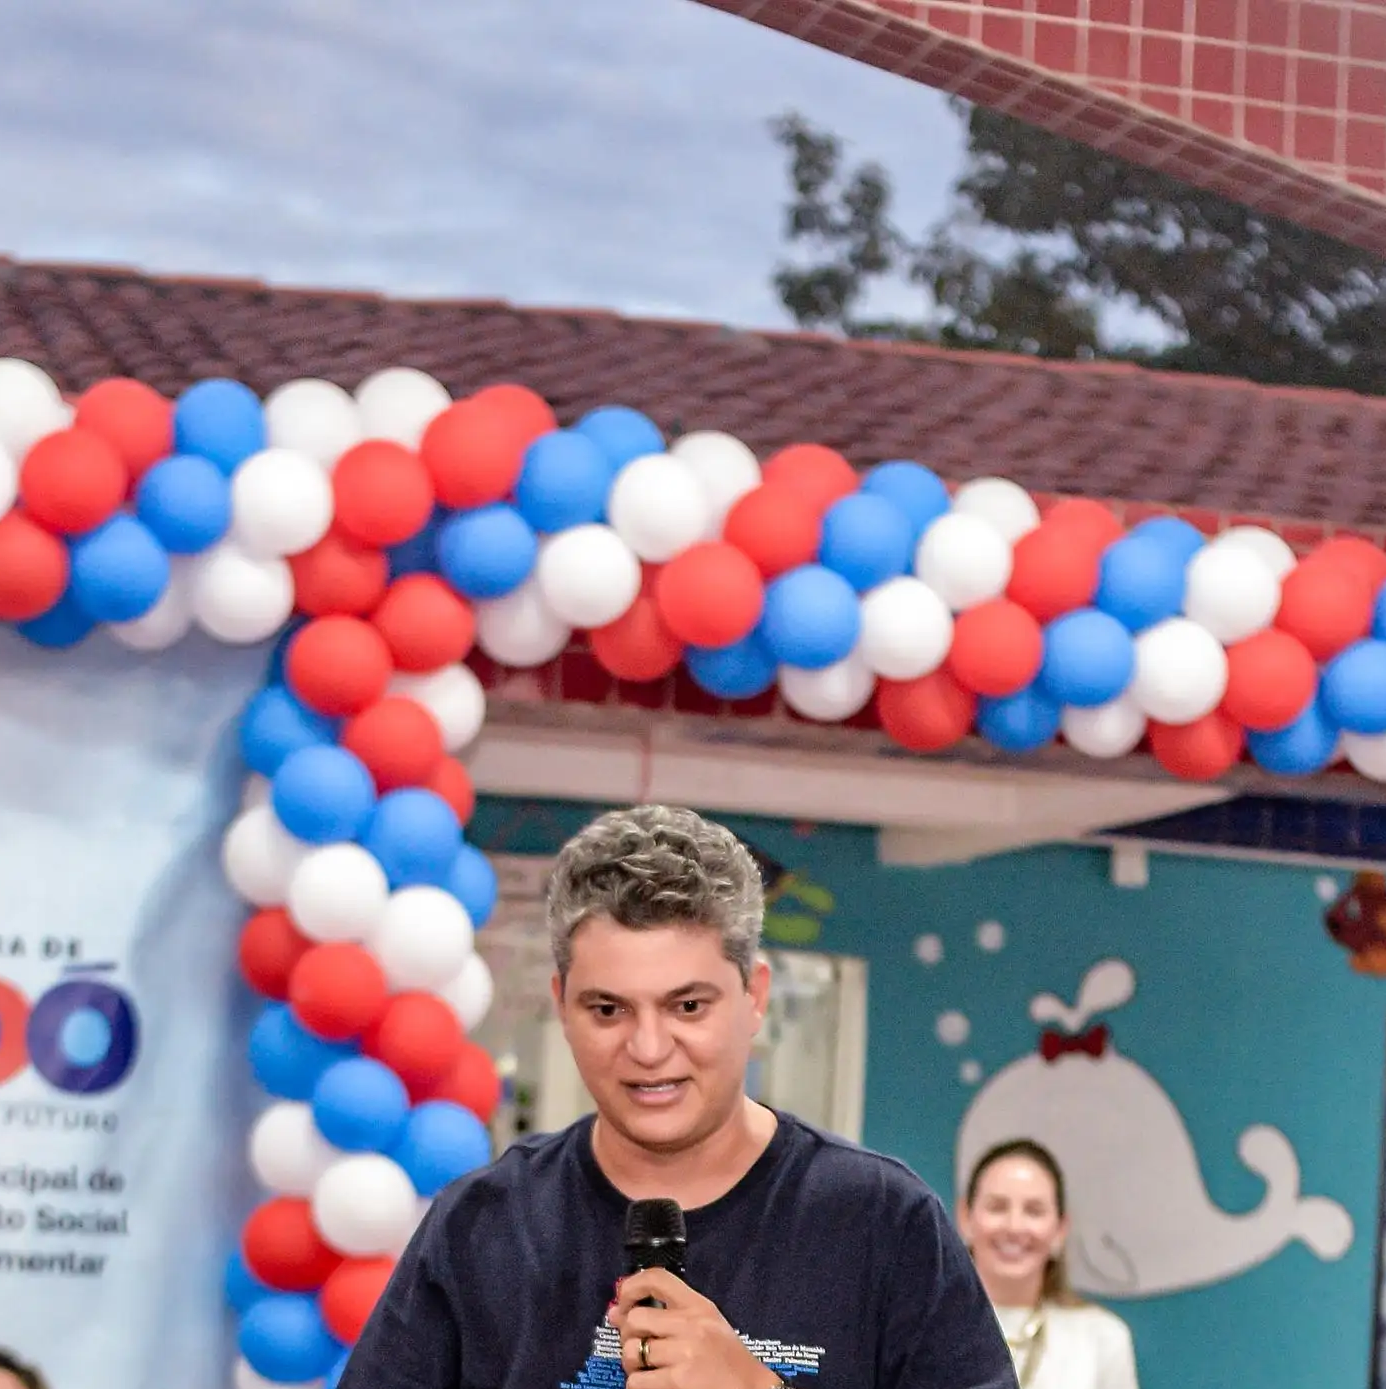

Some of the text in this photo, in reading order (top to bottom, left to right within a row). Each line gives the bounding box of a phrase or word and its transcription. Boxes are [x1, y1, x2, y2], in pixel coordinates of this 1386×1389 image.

[41, 936, 83, 959] DE
[88, 1166, 124, 1193] de
[36, 1205, 128, 1236] Social
